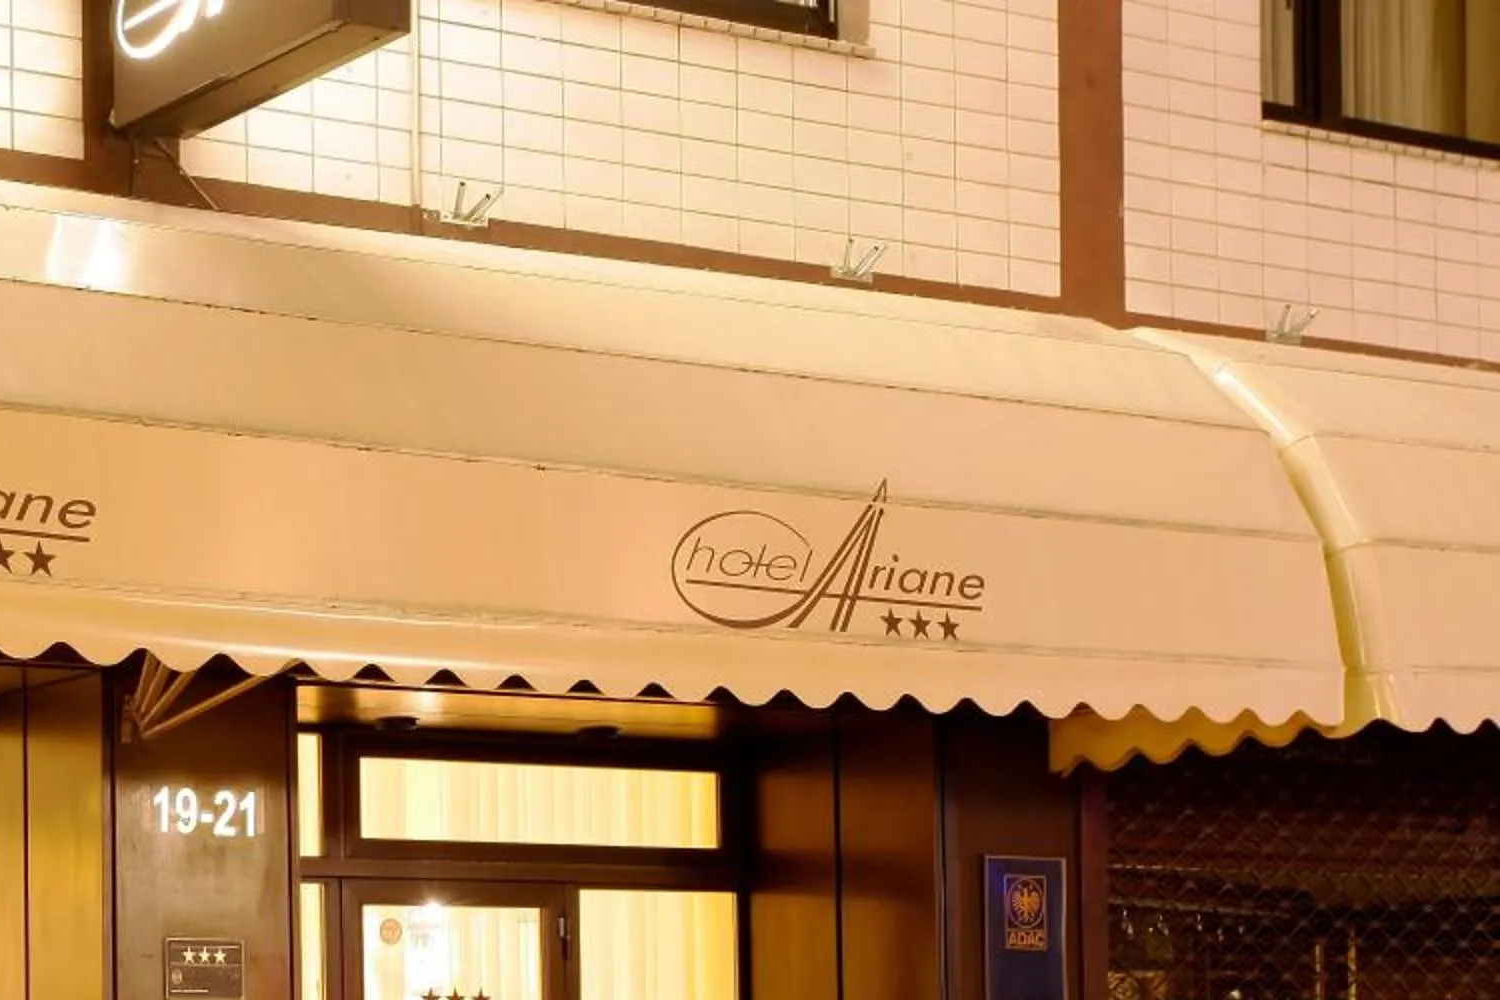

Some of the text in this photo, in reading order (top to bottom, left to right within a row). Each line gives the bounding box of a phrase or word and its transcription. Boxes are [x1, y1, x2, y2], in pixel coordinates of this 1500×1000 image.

[685, 478, 985, 632] hotel Ariane
[153, 785, 256, 837] 19-21
[1008, 930, 1046, 945] ADAC
